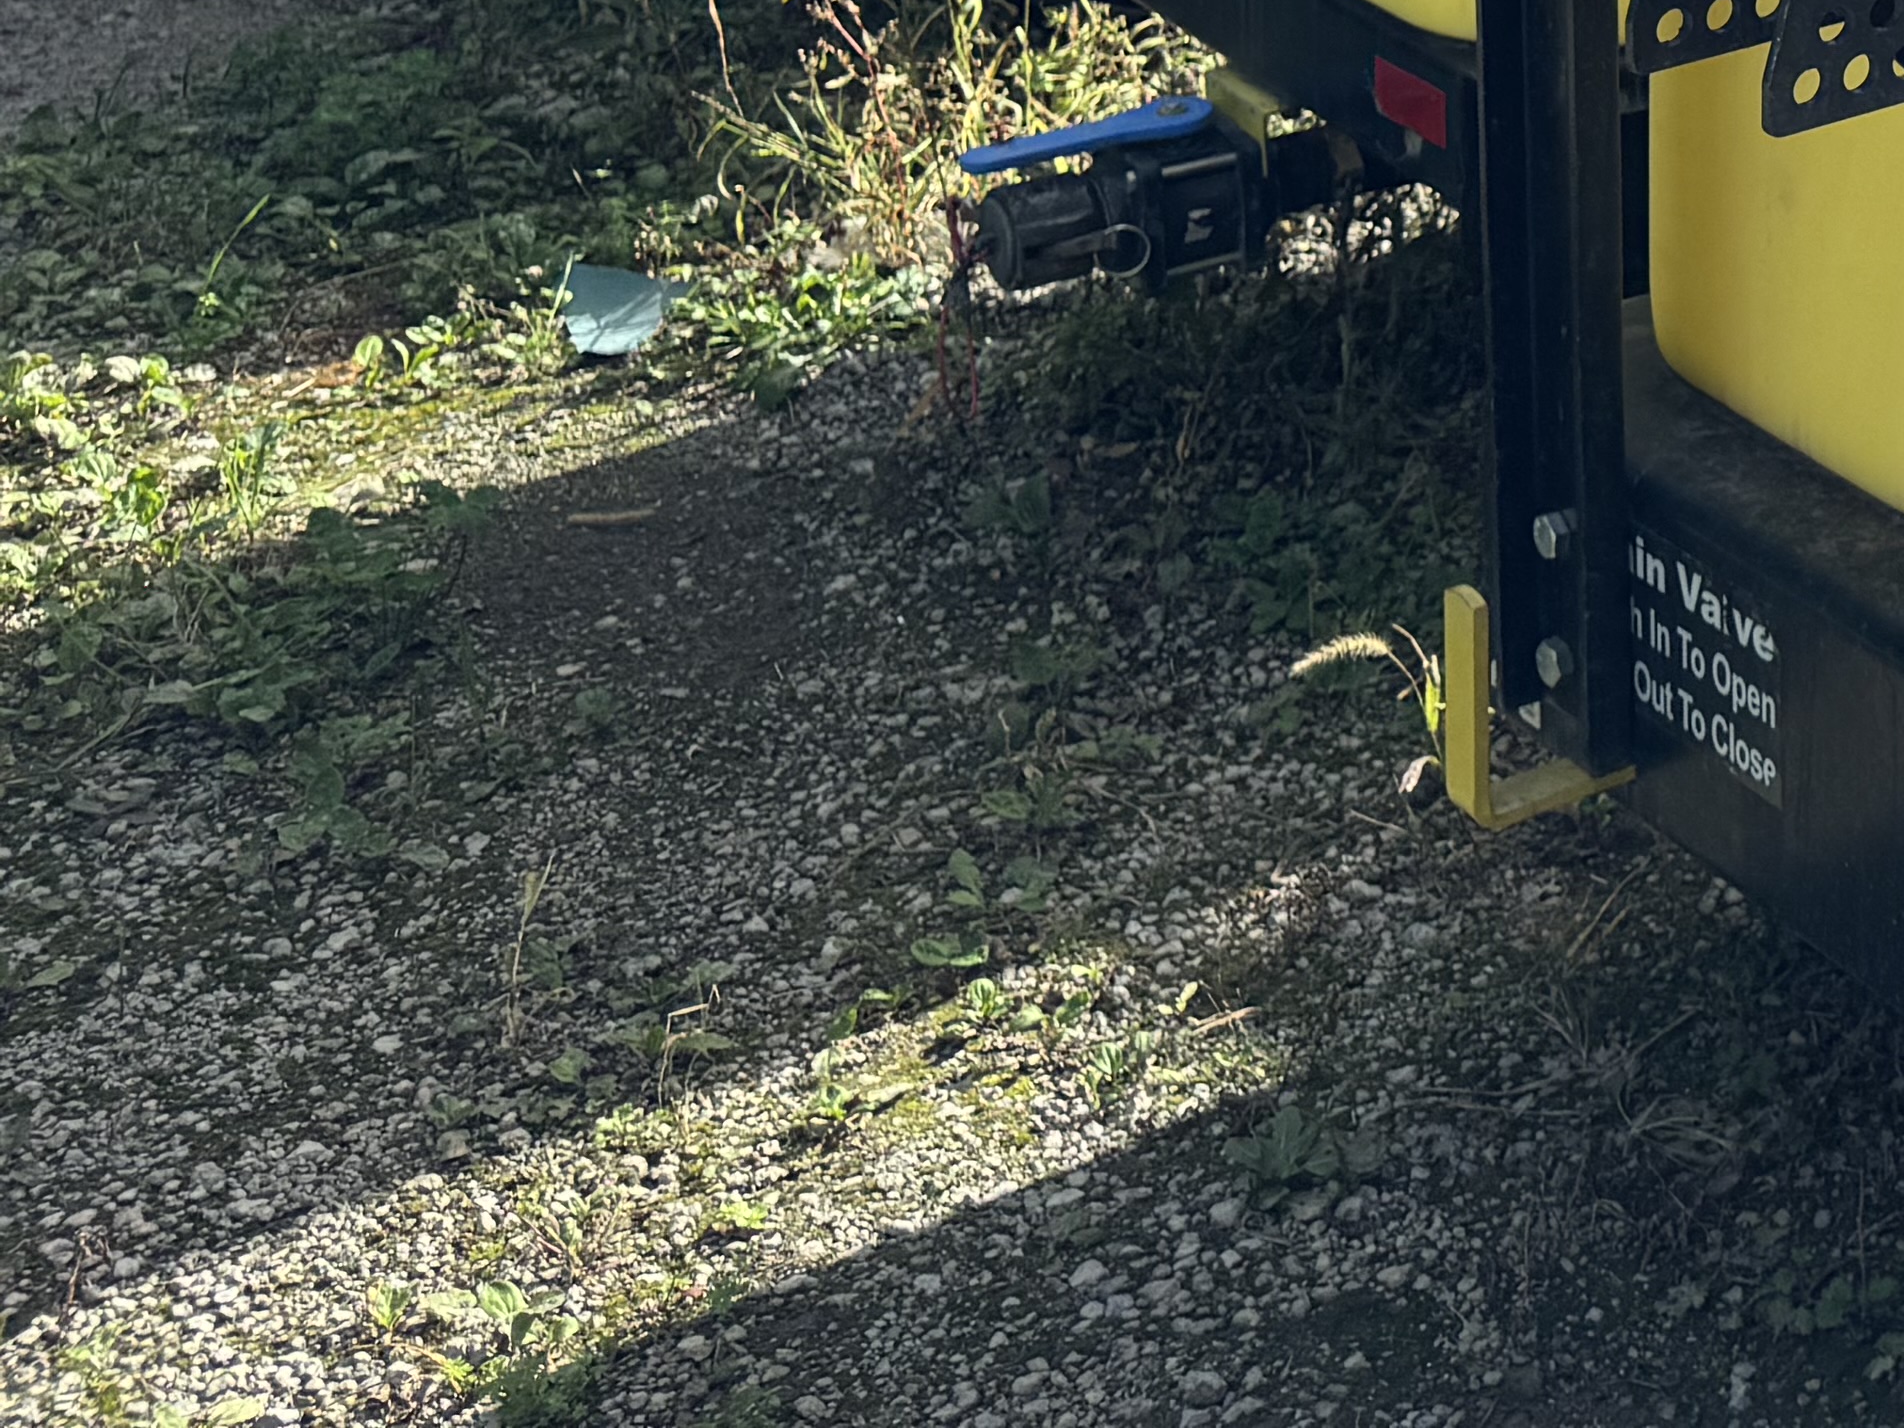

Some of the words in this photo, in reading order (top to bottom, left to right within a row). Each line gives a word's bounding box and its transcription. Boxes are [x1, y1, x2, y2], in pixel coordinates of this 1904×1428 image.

[1628, 535, 1666, 594] in
[1634, 660, 1674, 722] Out
[1677, 687, 1706, 741] To
[1711, 713, 1777, 787] Close
[1650, 607, 1671, 659] In
[1677, 625, 1706, 680] To
[1712, 651, 1777, 730] Open
